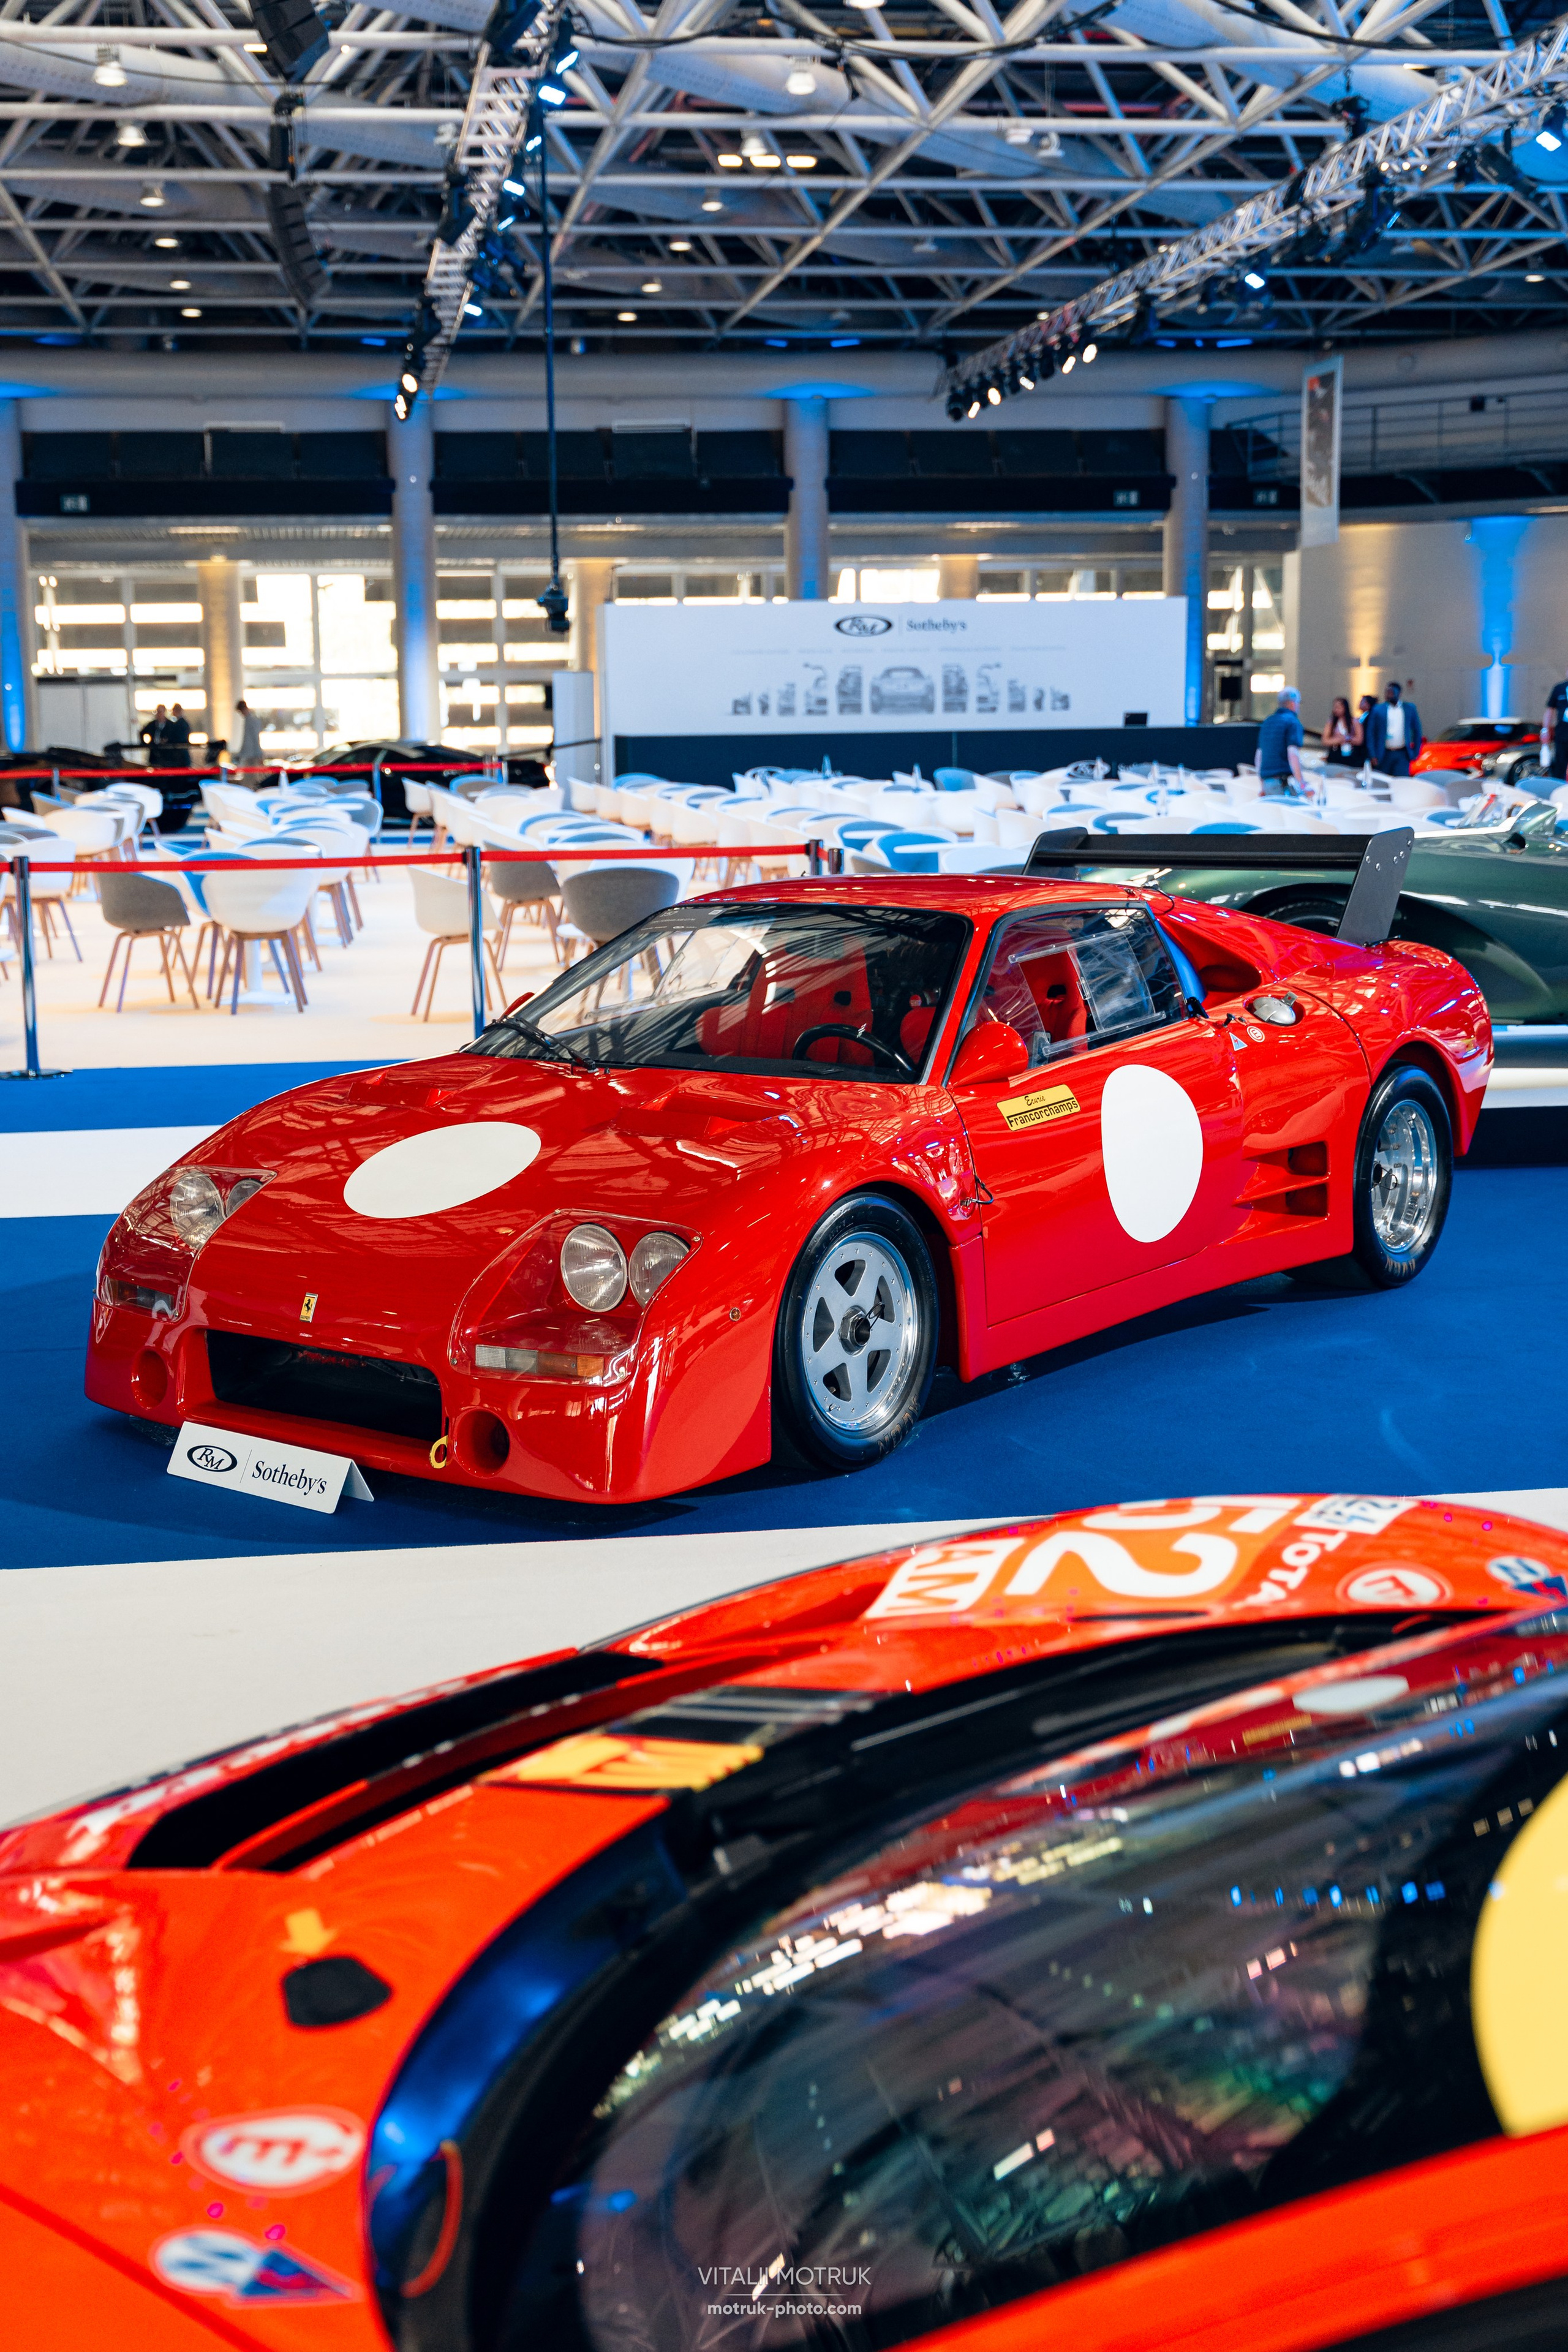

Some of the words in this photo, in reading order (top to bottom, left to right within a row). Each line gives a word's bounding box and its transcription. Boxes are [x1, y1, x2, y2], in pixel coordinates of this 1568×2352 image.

[907, 617, 967, 633] Sotheby's
[1251, 1029, 1261, 1040] E
[1024, 1095, 1046, 1106] Ecurie
[1006, 1100, 1079, 1127] Francorchamps
[252, 1460, 327, 1496] Sotheby's
